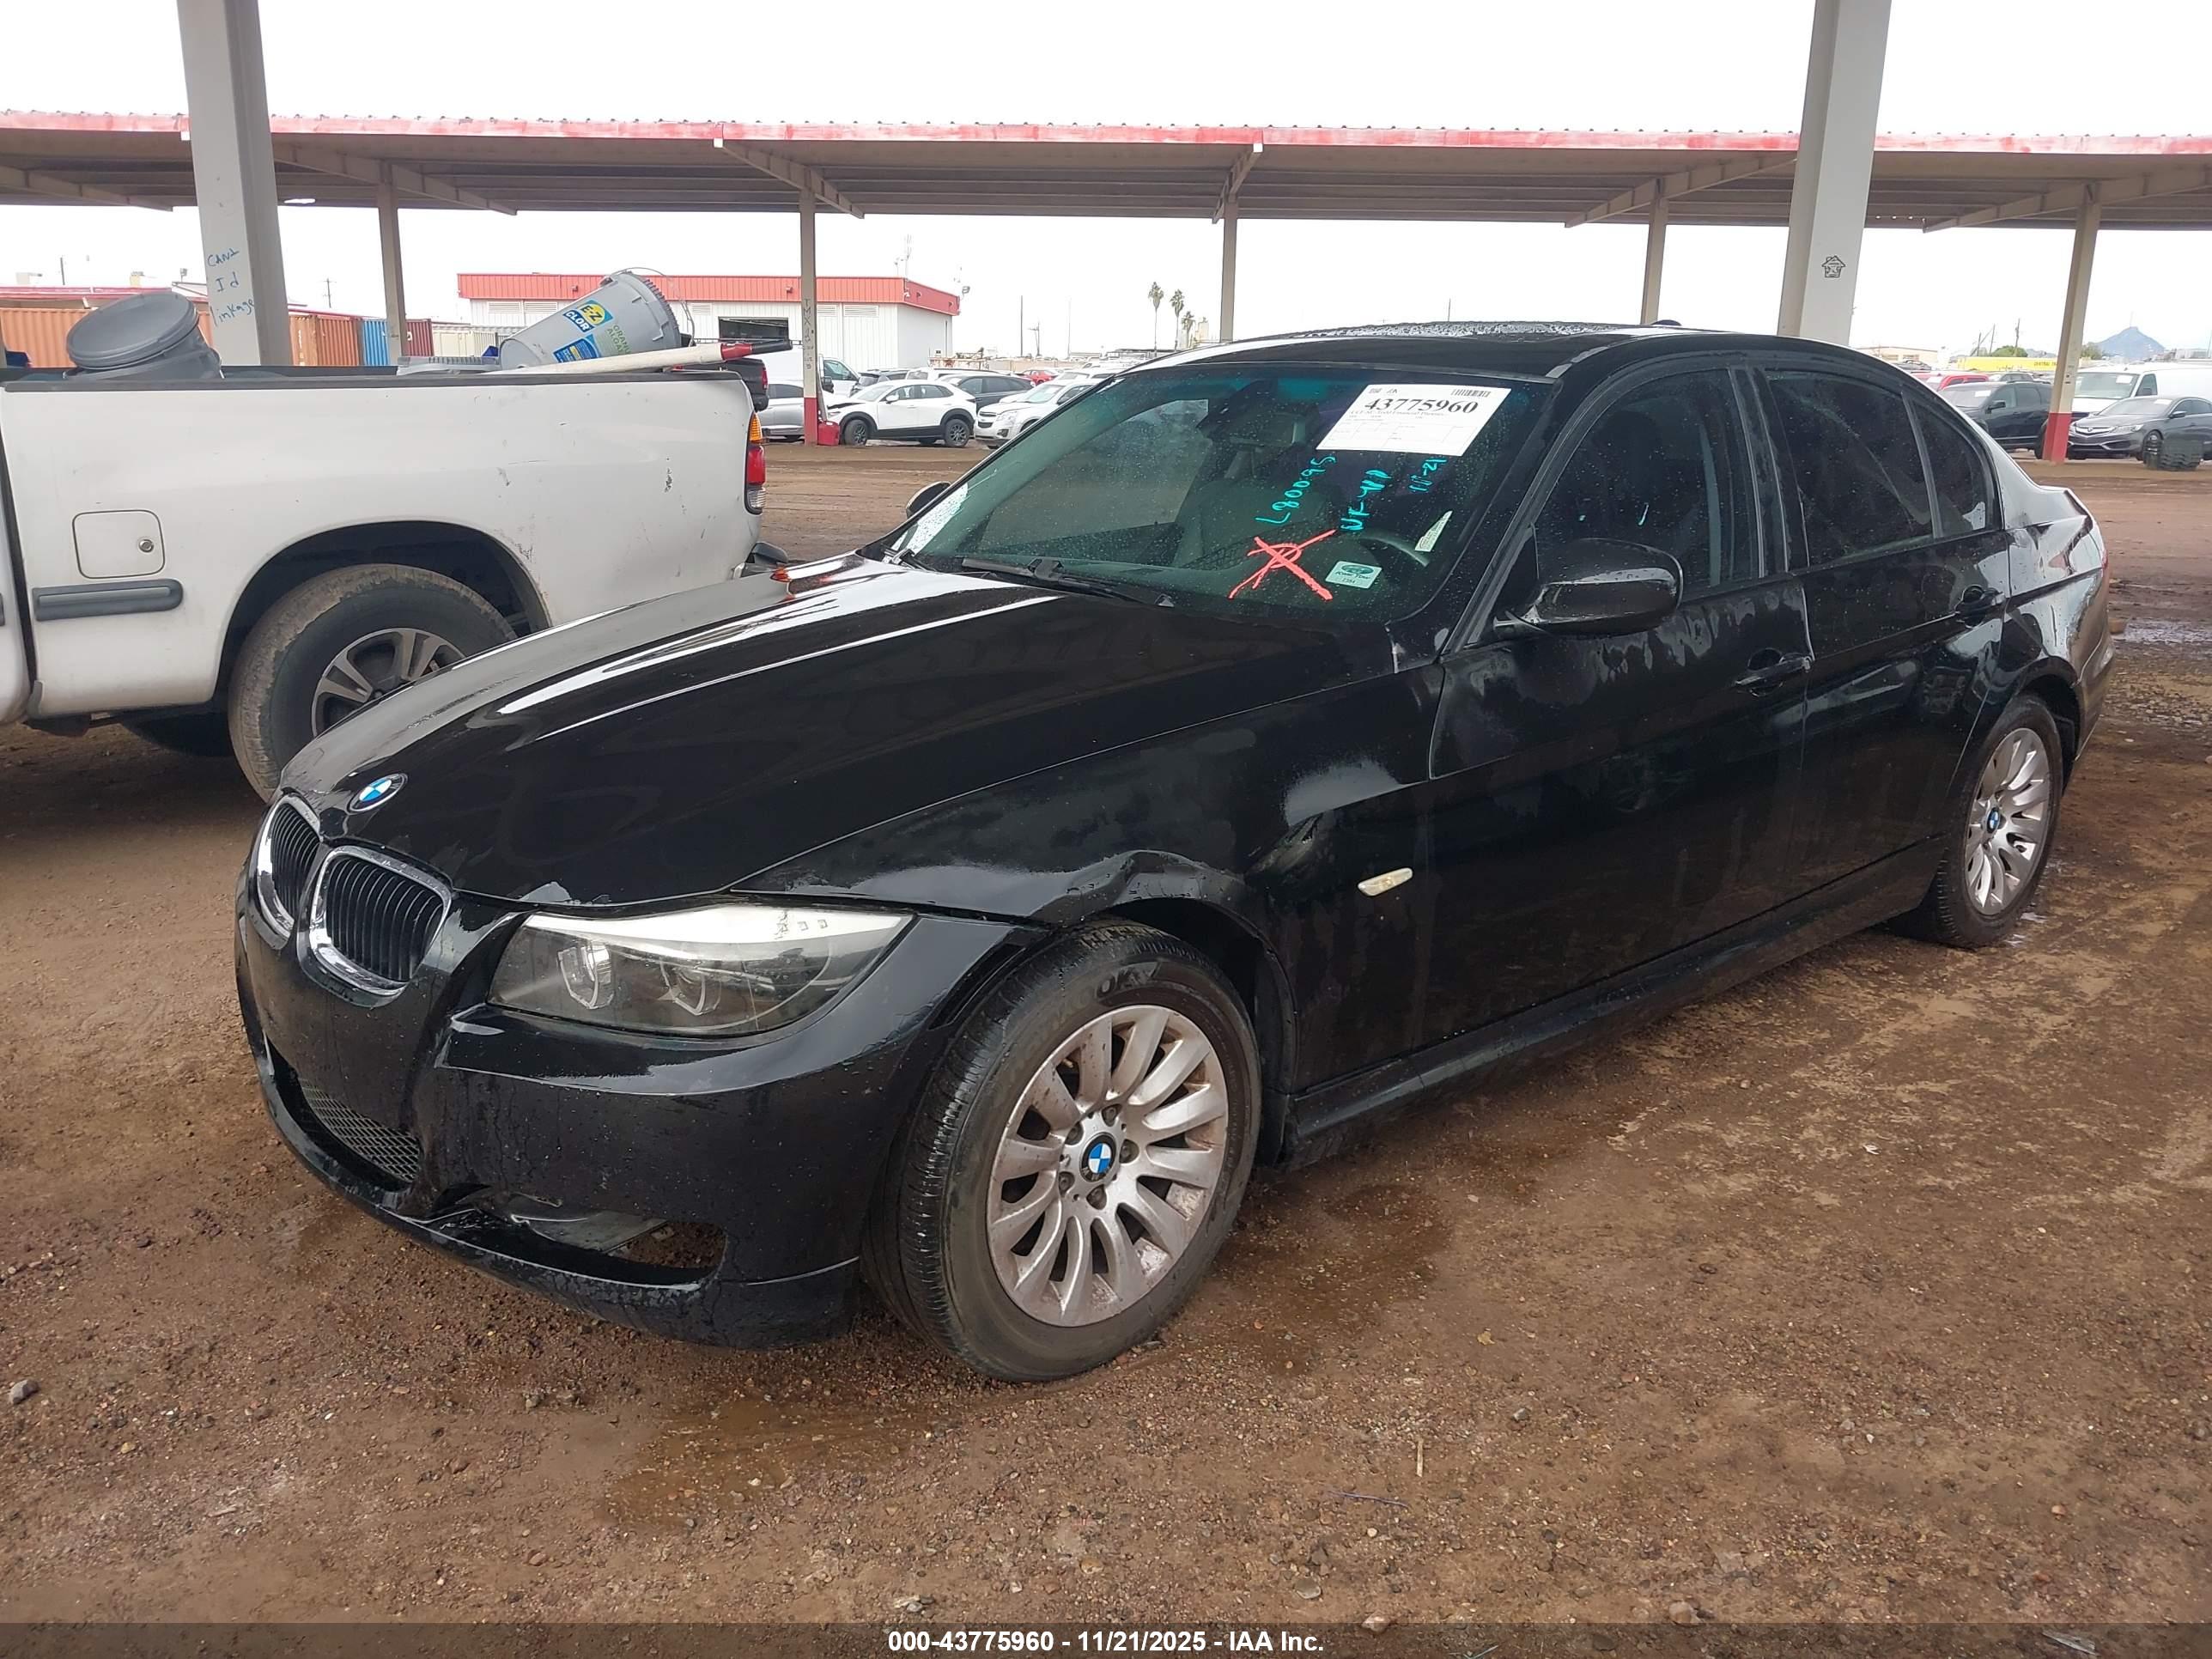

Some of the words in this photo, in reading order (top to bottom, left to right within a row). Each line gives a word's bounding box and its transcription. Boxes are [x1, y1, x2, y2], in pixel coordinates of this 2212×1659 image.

[565, 311, 591, 331] CLOR
[580, 305, 603, 322] E-Z
[1364, 398, 1479, 414] 43775960
